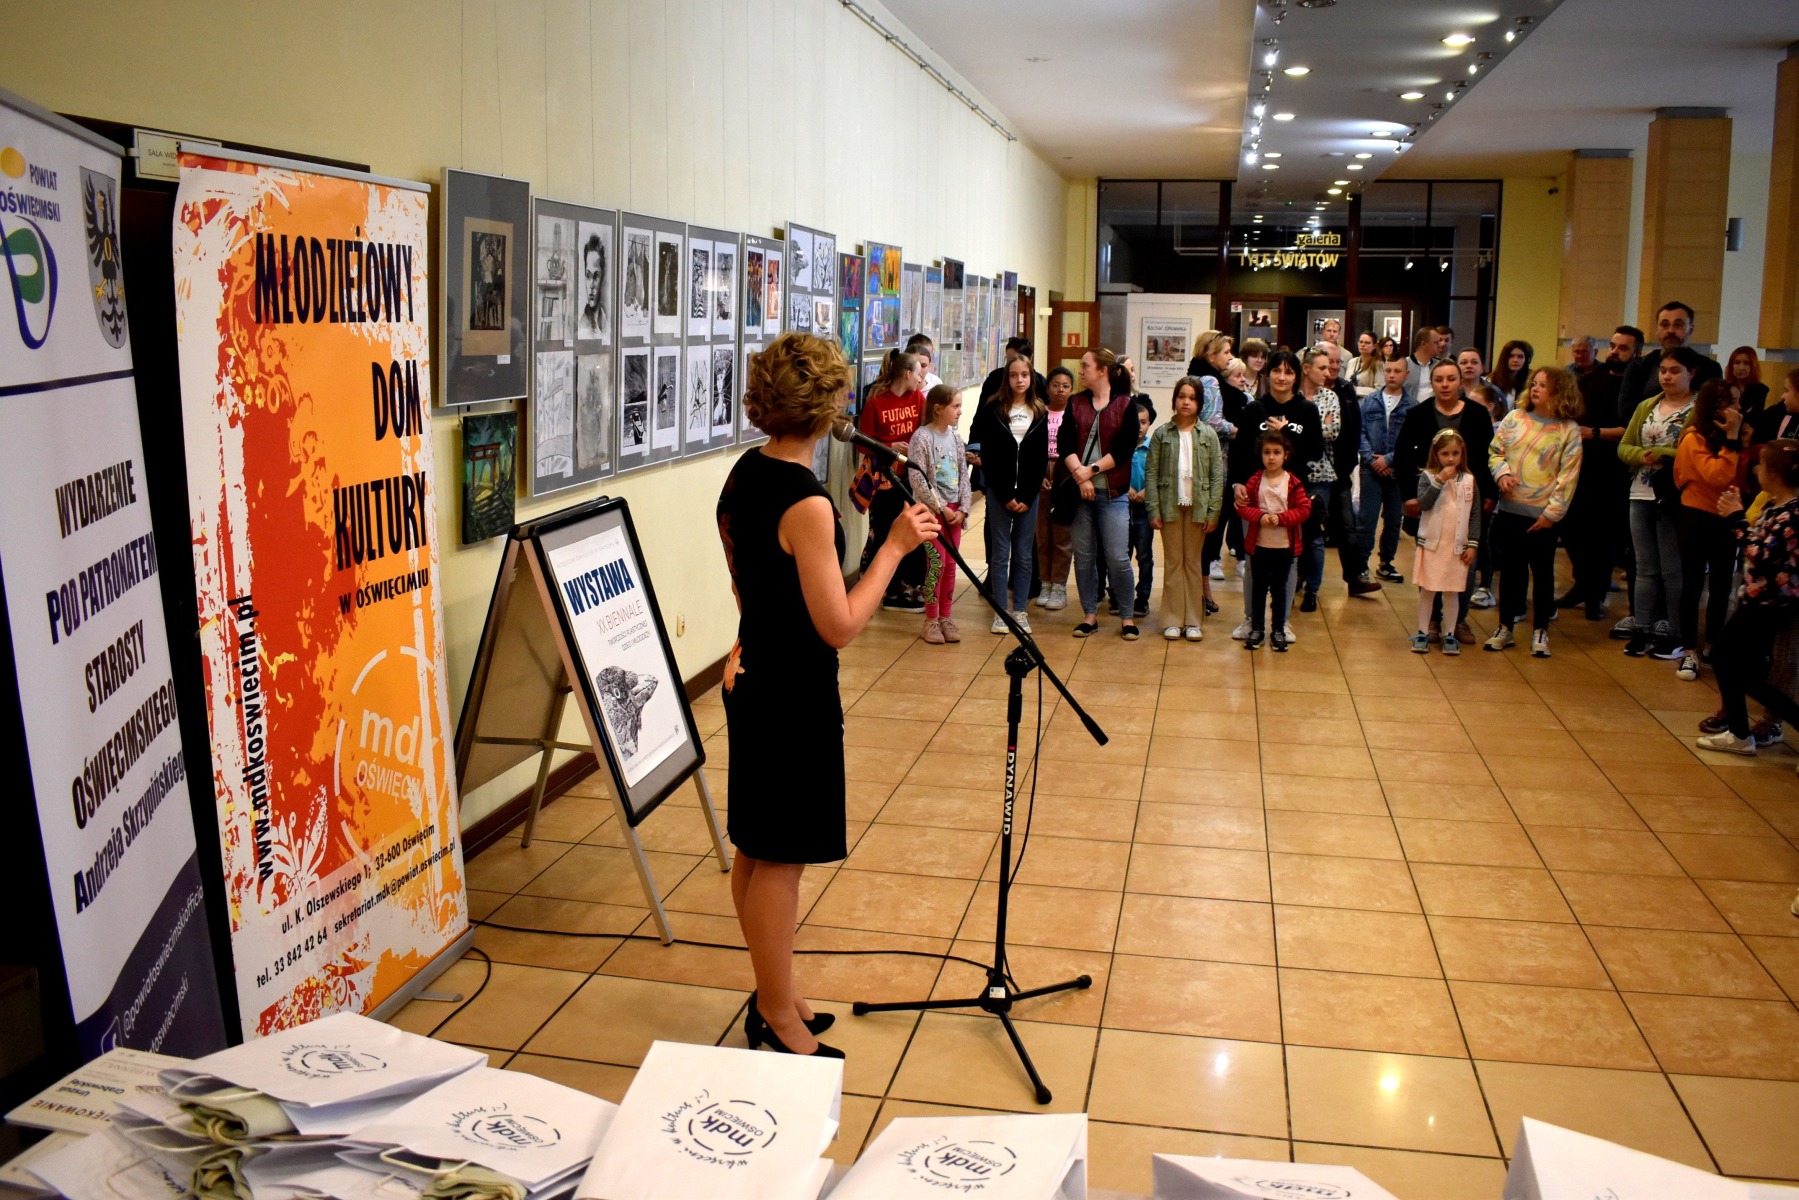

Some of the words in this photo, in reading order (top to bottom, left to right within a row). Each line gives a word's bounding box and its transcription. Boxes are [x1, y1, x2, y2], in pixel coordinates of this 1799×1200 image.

[0, 187, 61, 222] OŚWIĘCIMSKI
[29, 164, 58, 191] POWIAT
[254, 226, 415, 325] MŁODZIEŻOWY
[1274, 249, 1339, 268] ŚWIATÓW
[371, 359, 424, 441] DOM
[882, 405, 918, 423] FUTURE
[889, 421, 913, 436] STAR
[55, 459, 137, 539] WYDARZENIE
[333, 471, 428, 572] KULTURY
[46, 578, 80, 645] POD
[79, 531, 158, 622] PATRONATEM
[356, 567, 429, 609] OŚWIĘCIMIU
[563, 558, 635, 616] WYSTAWA
[606, 599, 644, 630] BIENNALE
[84, 619, 146, 714] STAROSTY
[71, 678, 177, 830] OŚWIĘCIMSKIEGO
[227, 594, 274, 883] www.mdkoswiecim.pl
[1003, 752, 1015, 835] DYNAWID
[74, 827, 125, 915] Andrzeja
[122, 749, 186, 848] Skrzypińskieg
[281, 917, 293, 935] ul.
[295, 908, 304, 925] K.
[306, 871, 362, 917] Olszewskiego
[375, 844, 401, 872] 32-600
[402, 824, 435, 852] Oświęcim
[123, 885, 204, 1039] @powiatoswiecimskiofficia
[256, 969, 272, 988] tel.
[274, 957, 285, 977] 33
[287, 944, 302, 967] 842
[304, 937, 315, 956] 42
[317, 926, 328, 945] 64
[486, 1120, 532, 1145] mdk
[700, 1115, 754, 1147] mdk
[937, 1152, 992, 1175] mdk
